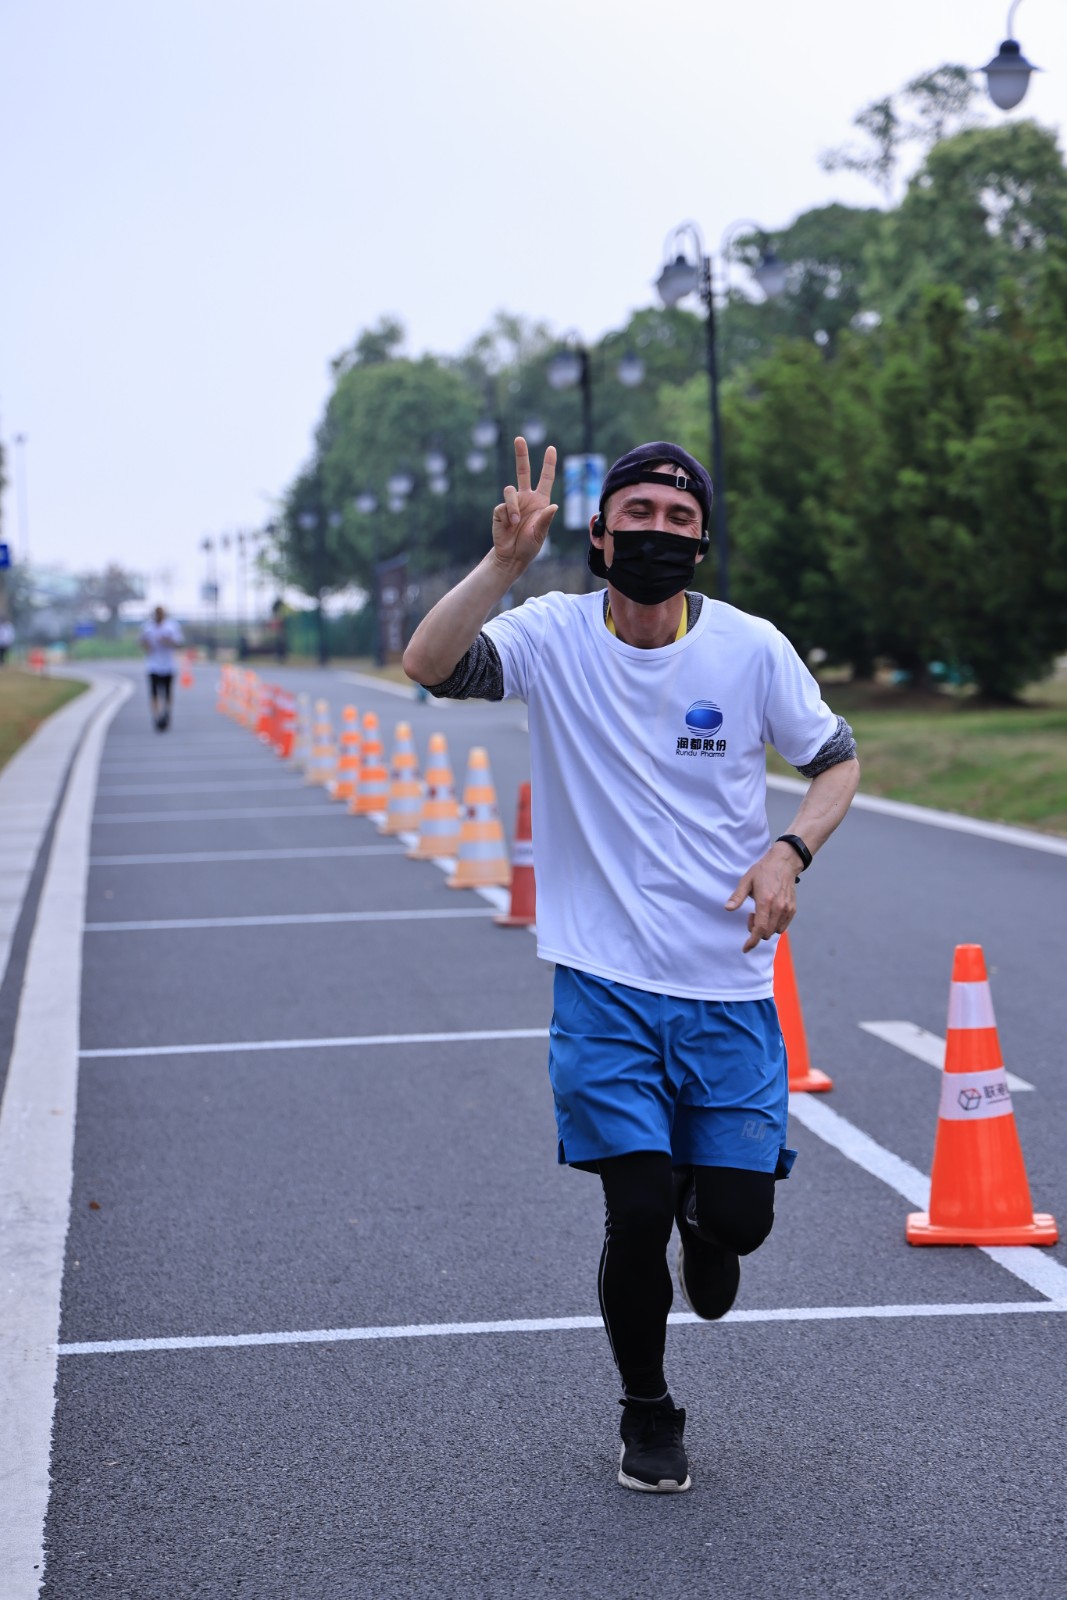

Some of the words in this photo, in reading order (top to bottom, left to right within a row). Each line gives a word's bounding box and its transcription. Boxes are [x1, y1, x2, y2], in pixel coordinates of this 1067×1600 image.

[677, 737, 726, 751] 润都股份
[676, 749, 697, 757] Rundu
[700, 750, 725, 758] Pharma
